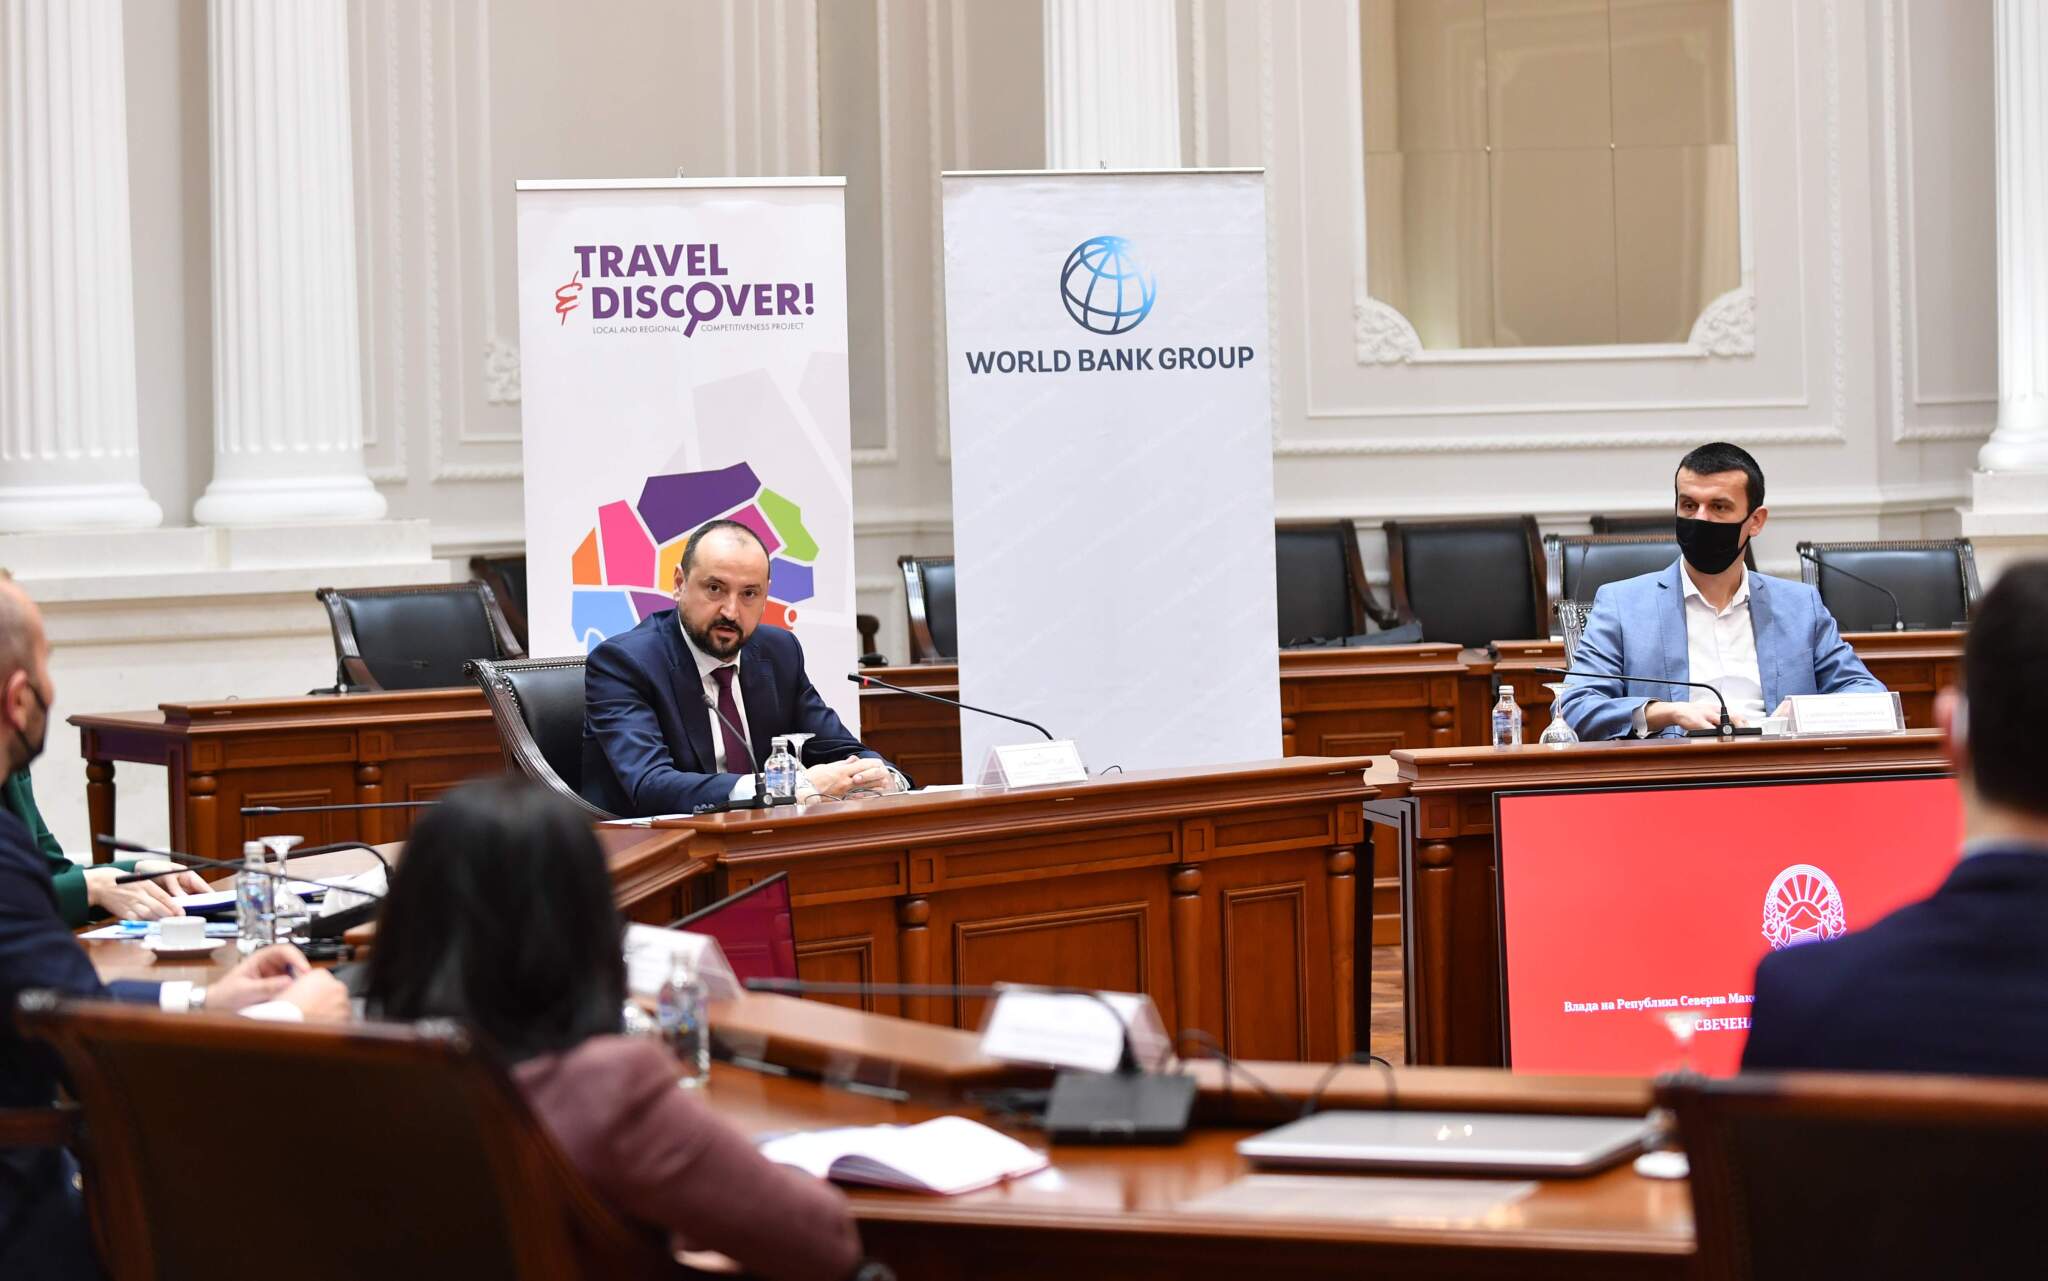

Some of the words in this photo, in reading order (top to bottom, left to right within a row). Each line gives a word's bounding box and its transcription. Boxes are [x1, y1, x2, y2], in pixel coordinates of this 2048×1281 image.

[574, 243, 728, 277] TRAVEL
[592, 281, 815, 338] DISCOVER!
[592, 326, 618, 335] LOCAL
[620, 326, 638, 334] AND
[640, 325, 680, 333] REGIONAL
[701, 322, 770, 332] COMPETITIVENESS
[772, 321, 804, 330] PROJECT
[965, 350, 1071, 374] WORLD
[1078, 348, 1154, 372] BANK
[1158, 346, 1254, 370] GROUP
[1564, 1001, 1599, 1013] Влада
[1601, 1002, 1615, 1011] на
[1616, 998, 1678, 1011] Република
[1680, 995, 1726, 1008] Северна
